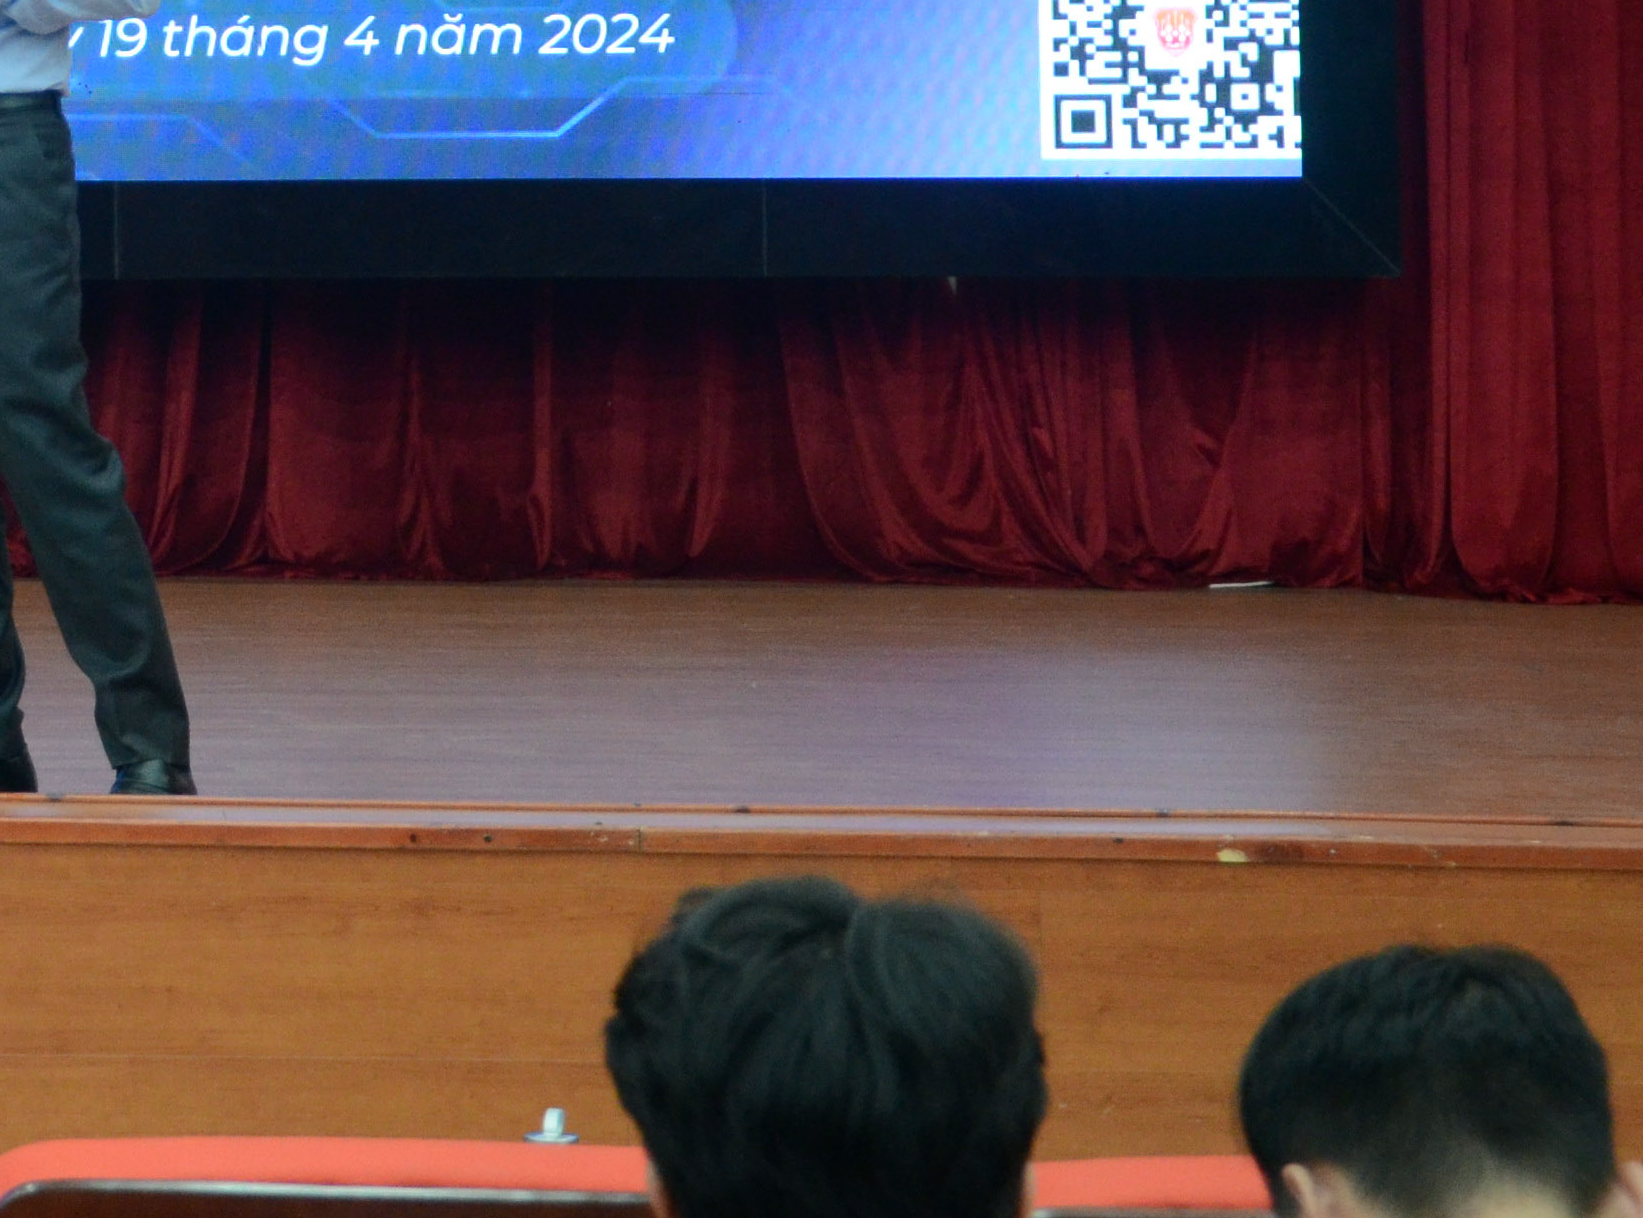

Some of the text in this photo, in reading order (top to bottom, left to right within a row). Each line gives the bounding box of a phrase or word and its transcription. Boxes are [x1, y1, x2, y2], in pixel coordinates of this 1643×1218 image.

[99, 18, 147, 57] 19
[163, 14, 328, 66] tháng
[344, 15, 380, 55] 4
[395, 13, 523, 55] năm
[538, 13, 676, 54] 2024
